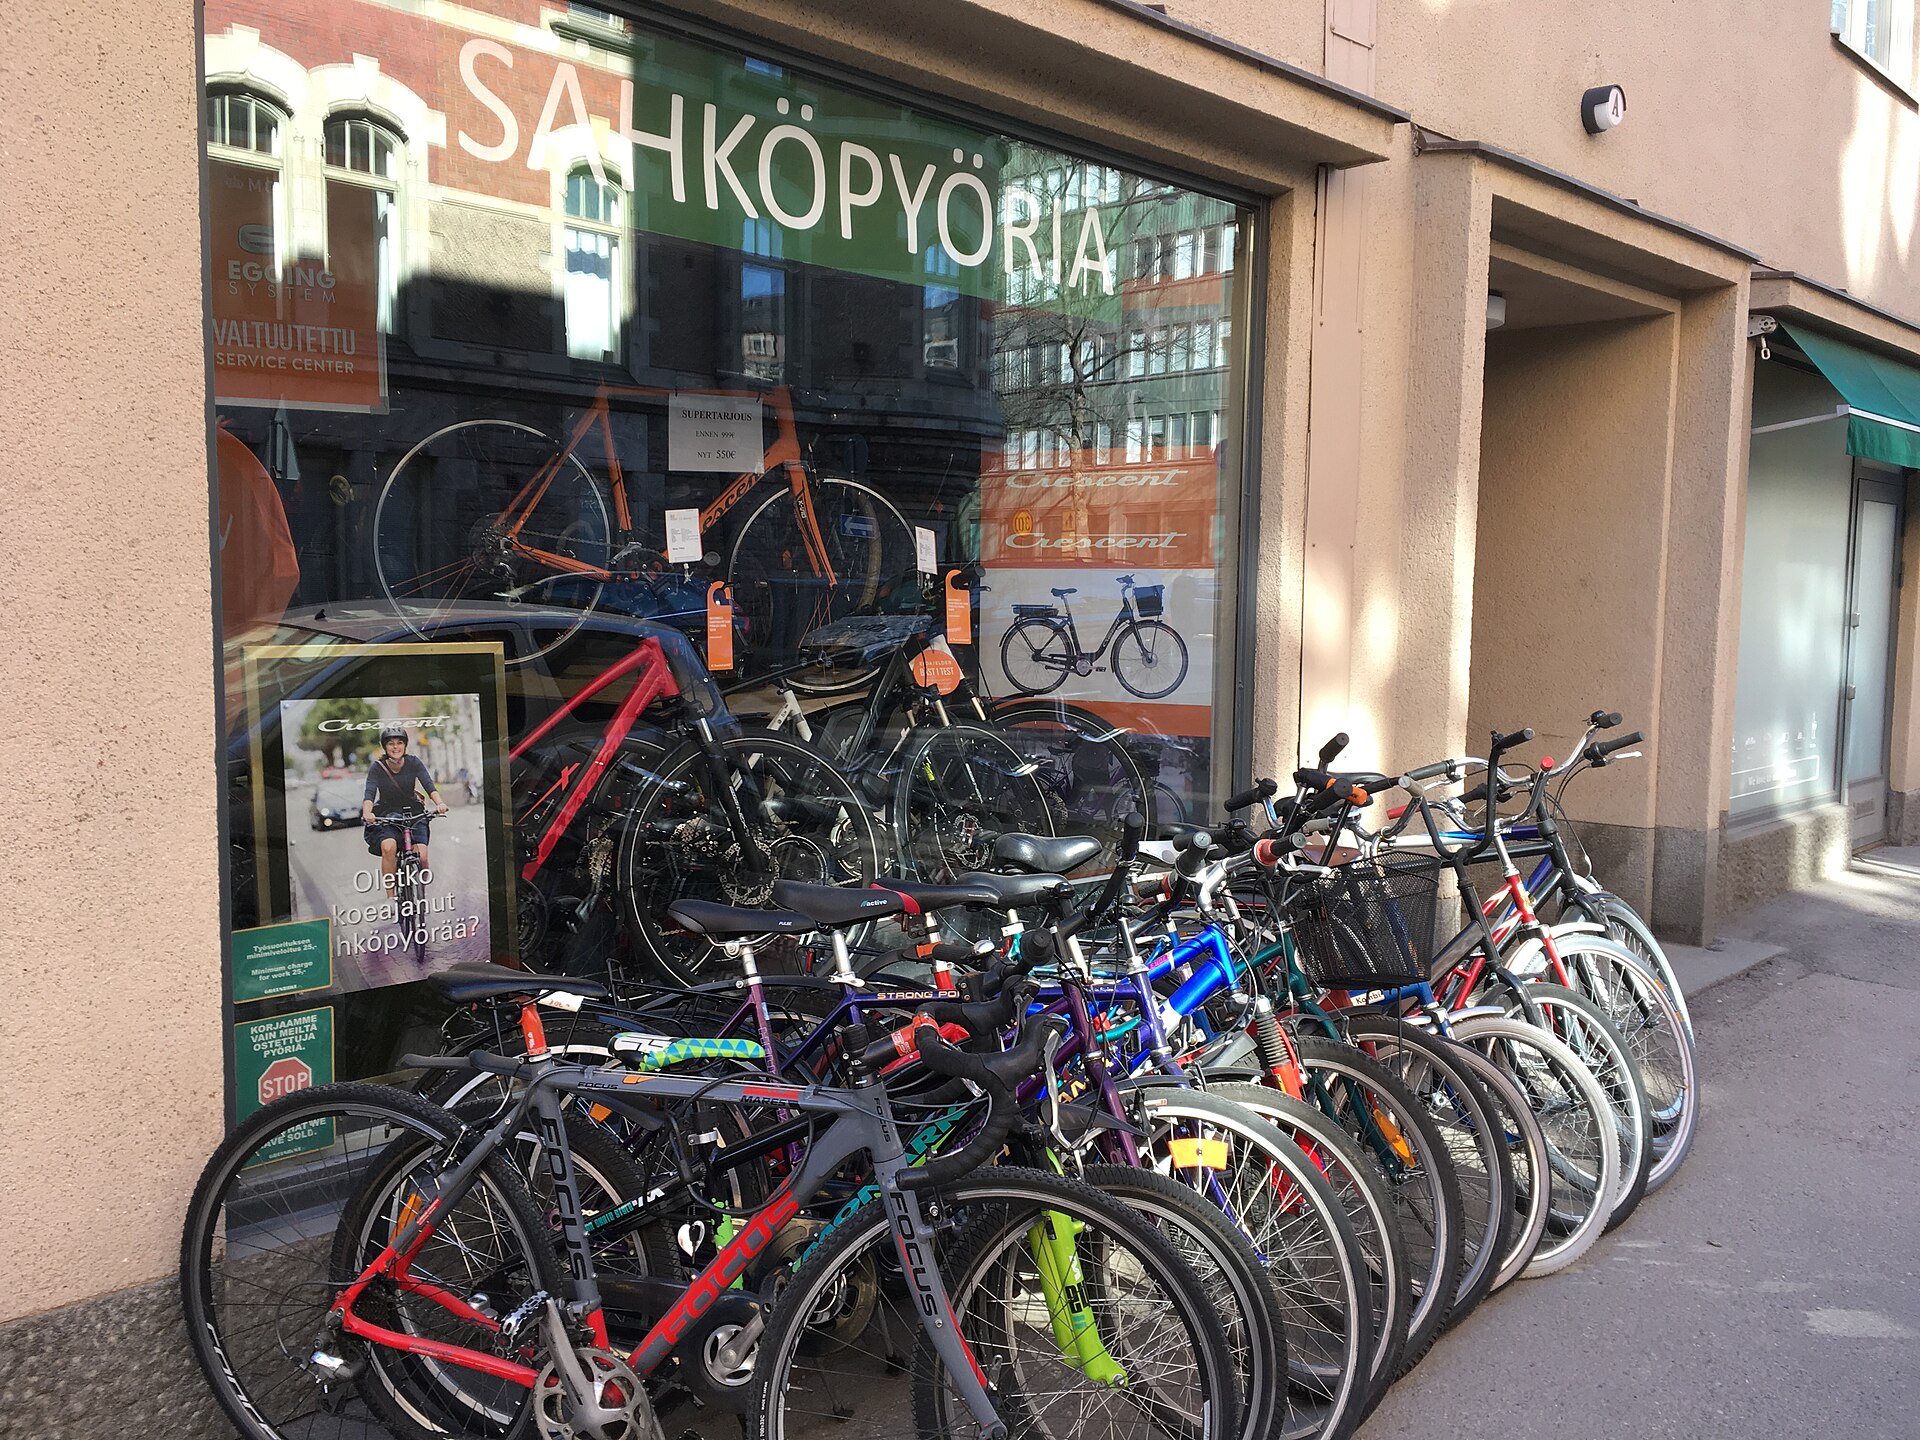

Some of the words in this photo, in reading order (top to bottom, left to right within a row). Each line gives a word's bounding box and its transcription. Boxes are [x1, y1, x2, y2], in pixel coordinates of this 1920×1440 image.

[1611, 93, 1620, 118] A
[457, 37, 1115, 297] SÄHKÖPYÖRIÄ
[229, 281, 336, 304] SYSTEM
[213, 319, 356, 355] VALTUUTETTU
[216, 352, 287, 370] SERVICE
[292, 357, 354, 374] CENTER
[681, 410, 752, 422] SUPERTARJOUS
[695, 430, 719, 438] ENNEN
[721, 430, 735, 439] 999€
[697, 451, 712, 459] NYT
[716, 449, 737, 460] 550€
[1005, 468, 1189, 489] Crescent
[1005, 531, 1188, 550] Crescent
[317, 715, 451, 733] Crescent
[352, 866, 434, 893] Oletko
[331, 891, 455, 928] koeajanut
[866, 898, 888, 907] active
[336, 915, 481, 957] hköpyörää?
[246, 946, 302, 960] minimiveloitus
[252, 938, 311, 954] Työsuorituksen
[251, 965, 286, 976] Minimum
[287, 961, 313, 971] charge
[258, 973, 270, 981] for
[271, 971, 291, 980] work
[877, 991, 934, 1000] STRONG
[250, 1014, 318, 1035] KORJAAMME
[250, 1030, 277, 1043] VAIN
[279, 1022, 318, 1038] MEILTÄ
[252, 1033, 317, 1051] OSTETTUJA
[263, 1041, 306, 1058] PYÖRIÄ.
[263, 1070, 311, 1099] STOP
[577, 1081, 619, 1090] FOCUS
[741, 1095, 787, 1107] MARES
[287, 1129, 318, 1143] SOLD.
[540, 1116, 590, 1283] FOCUS
[890, 1191, 941, 1318] FOCUS
[661, 1189, 801, 1346] FOCUS
